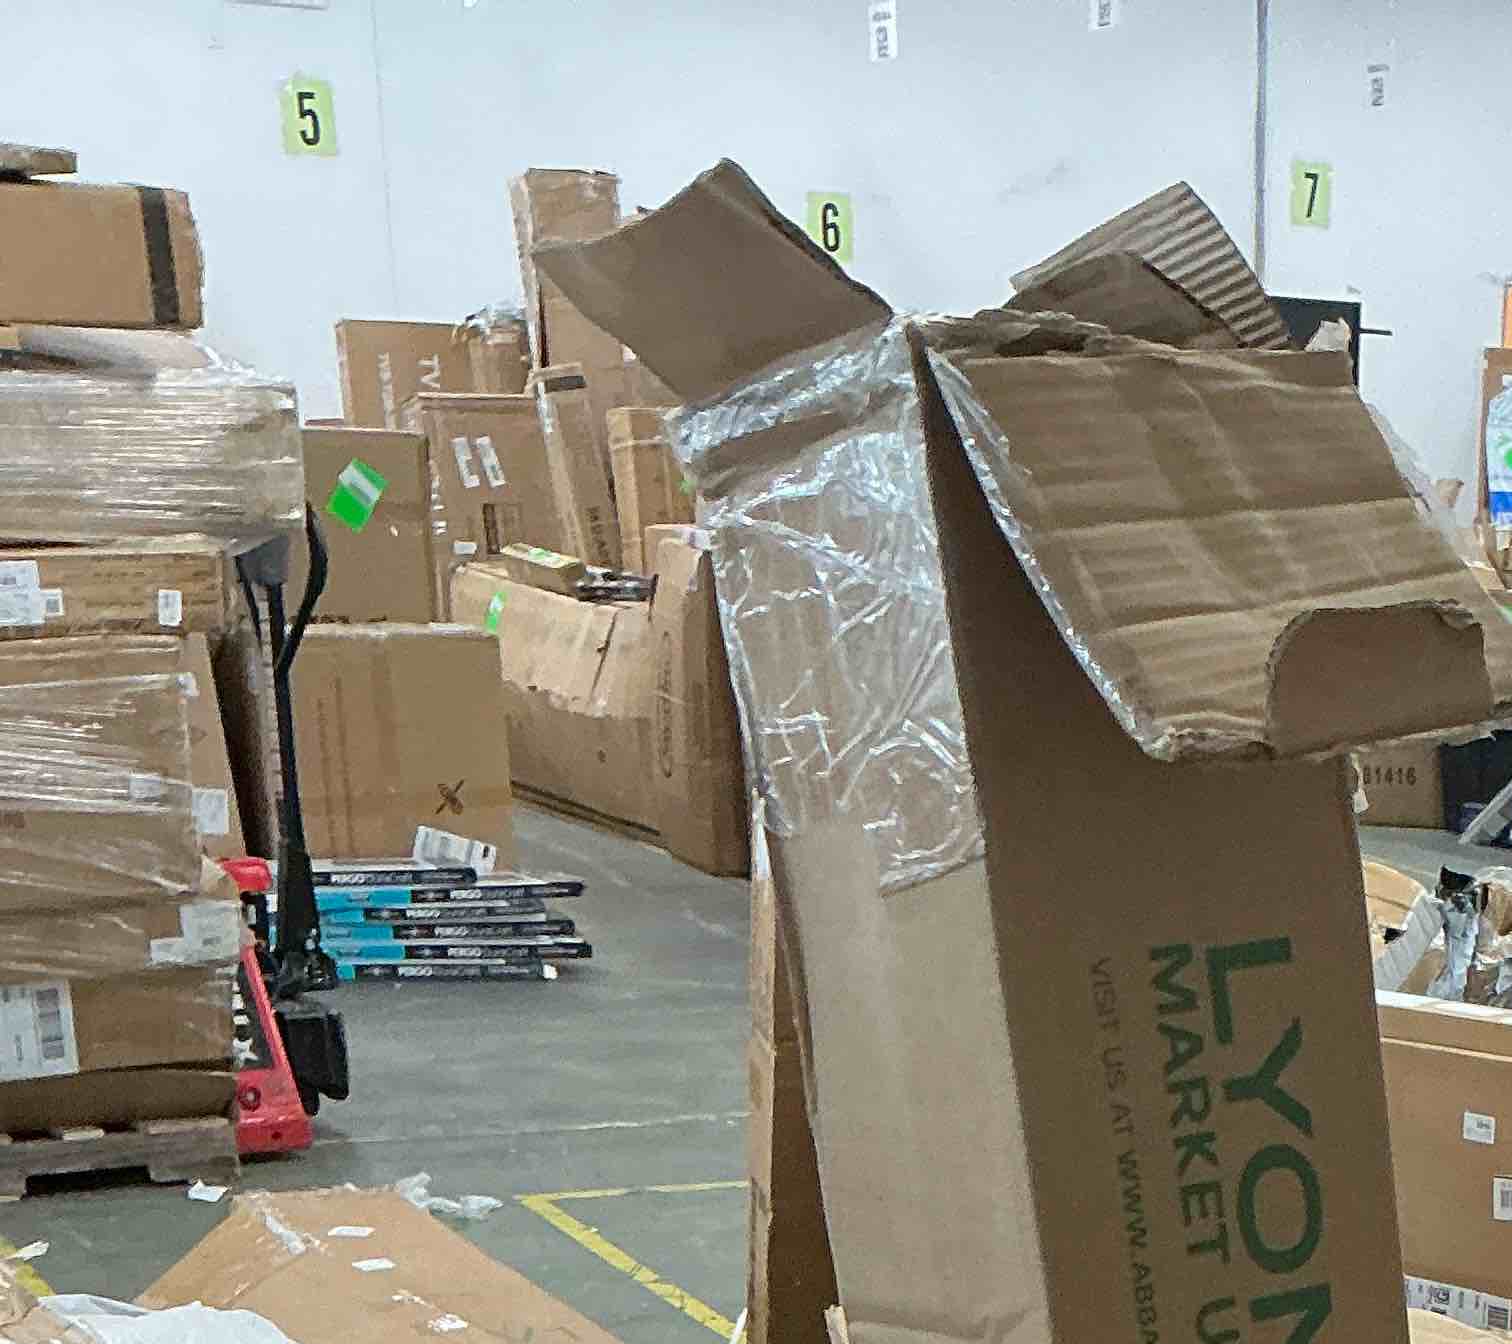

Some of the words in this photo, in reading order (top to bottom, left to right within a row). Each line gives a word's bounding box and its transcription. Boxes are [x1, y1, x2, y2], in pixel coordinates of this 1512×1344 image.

[297, 90, 322, 147] 5
[1304, 172, 1319, 218] 7
[822, 203, 839, 252] 6
[1090, 957, 1120, 1034] VISIT
[1104, 1047, 1126, 1093] US
[1111, 1102, 1135, 1137] AT
[1150, 943, 1232, 1265] MARKET
